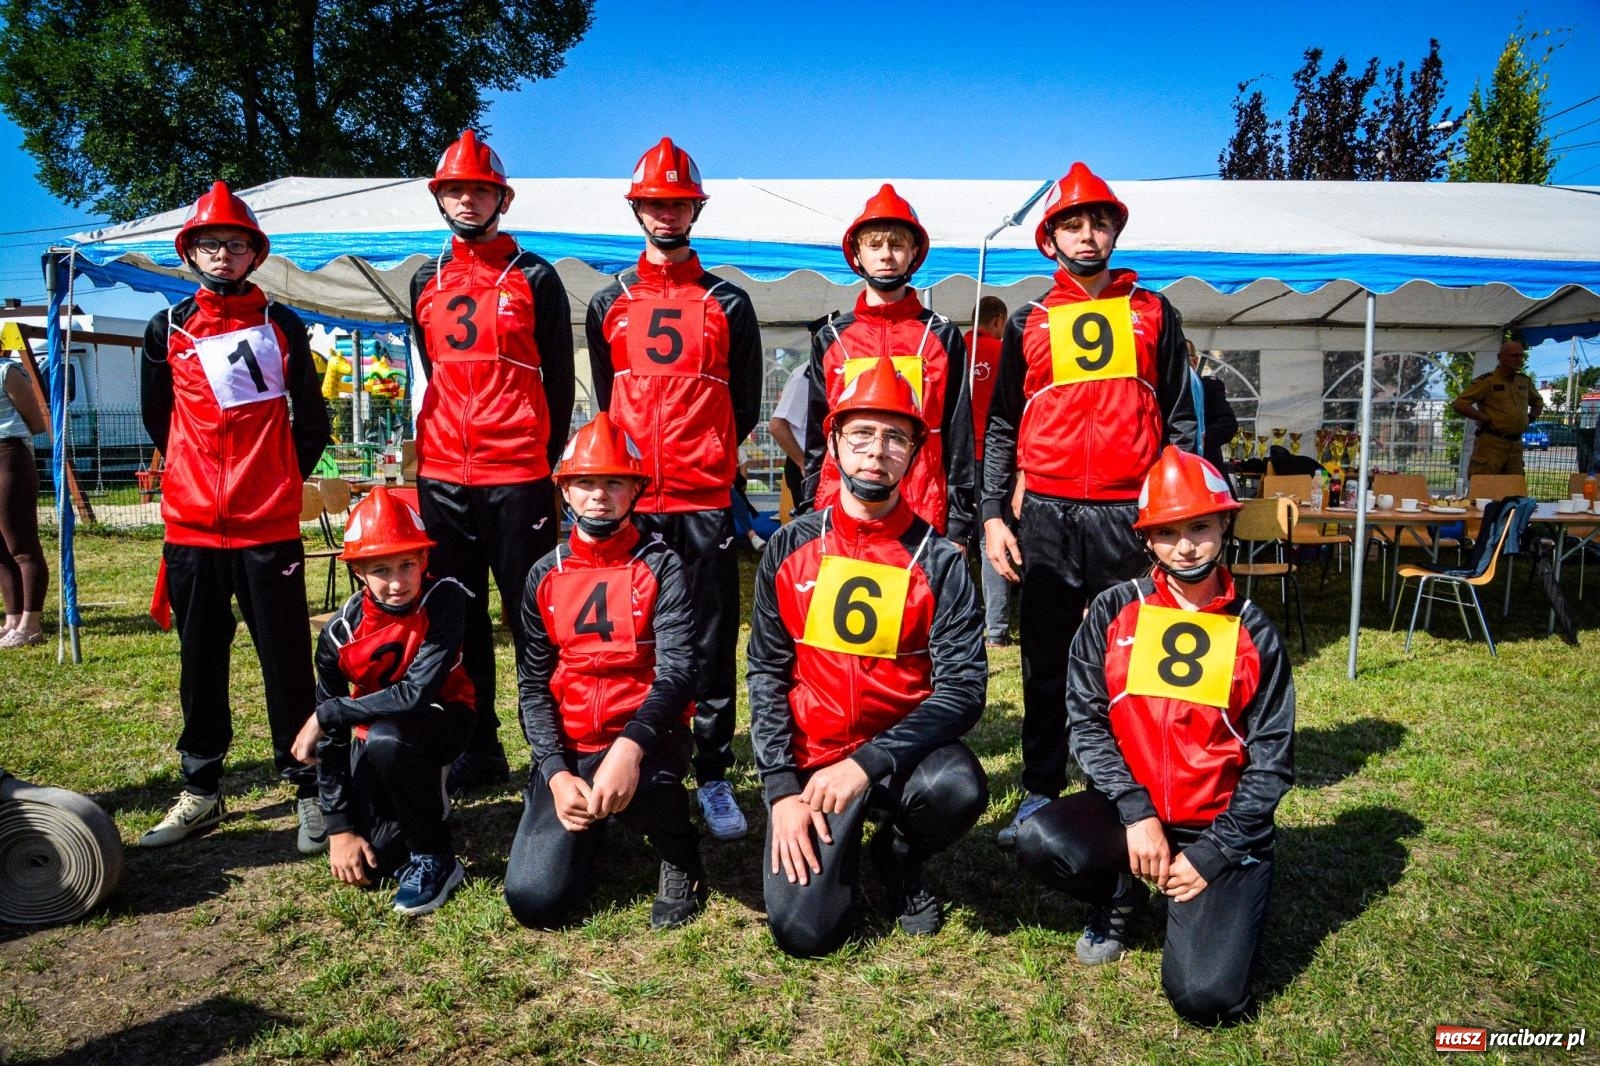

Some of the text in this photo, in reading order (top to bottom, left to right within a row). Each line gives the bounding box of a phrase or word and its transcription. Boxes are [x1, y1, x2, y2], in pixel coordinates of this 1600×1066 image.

[446, 295, 478, 350] 3
[646, 308, 683, 364] 5
[1072, 312, 1113, 371] 9
[227, 339, 269, 394] 1
[574, 583, 614, 642] 4
[833, 576, 882, 644] 6
[1157, 622, 1211, 687] 8
